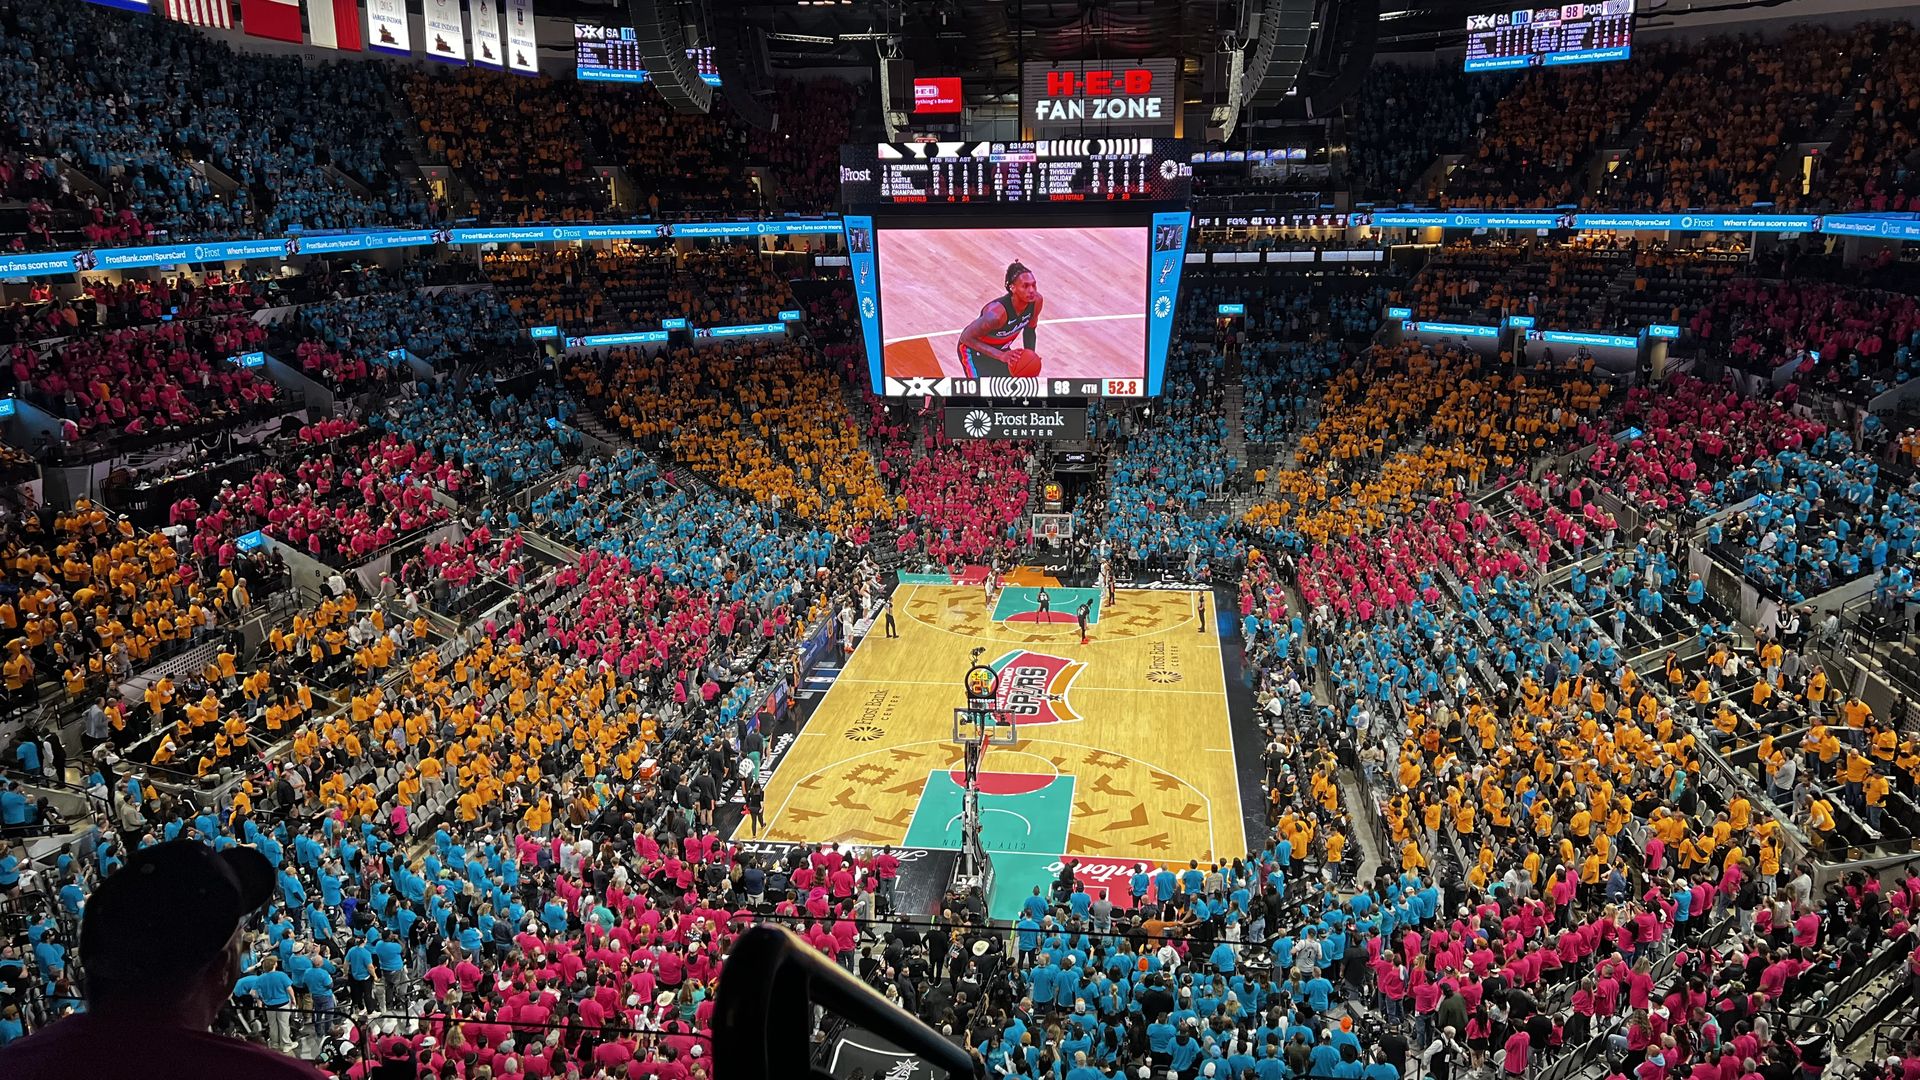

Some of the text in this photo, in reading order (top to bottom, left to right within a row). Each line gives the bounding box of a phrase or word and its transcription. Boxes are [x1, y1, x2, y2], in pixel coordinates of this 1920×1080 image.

[1566, 6, 1578, 18] 98
[1584, 4, 1603, 15] POR
[1497, 14, 1510, 25] SA
[1515, 12, 1528, 23] 110
[606, 28, 620, 38] SA
[1036, 98, 1162, 120] FAN ZONE
[845, 168, 872, 182] Frost
[766, 224, 781, 232] Frost
[1693, 218, 1714, 227] Frost
[1748, 219, 1766, 227] fans
[564, 229, 581, 237] Frost
[204, 248, 220, 258] Frost
[226, 246, 242, 255] Where
[244, 246, 255, 254] fans
[106, 251, 186, 264] FrostBank.com/SpursCard
[9, 262, 26, 272] fans
[28, 260, 48, 270] score
[50, 260, 68, 268] more
[954, 380, 976, 394] 110
[1054, 380, 1070, 395] 98
[1081, 383, 1098, 394] 4TH
[1107, 380, 1137, 394] 52.8
[994, 411, 1065, 427] Frost Bank
[1138, 581, 1213, 590] Antonio
[1000, 668, 1014, 697] ANTONIO
[1006, 666, 1049, 716] SPURS
[854, 689, 889, 725] Frost Bank
[881, 695, 900, 720] CENTER
